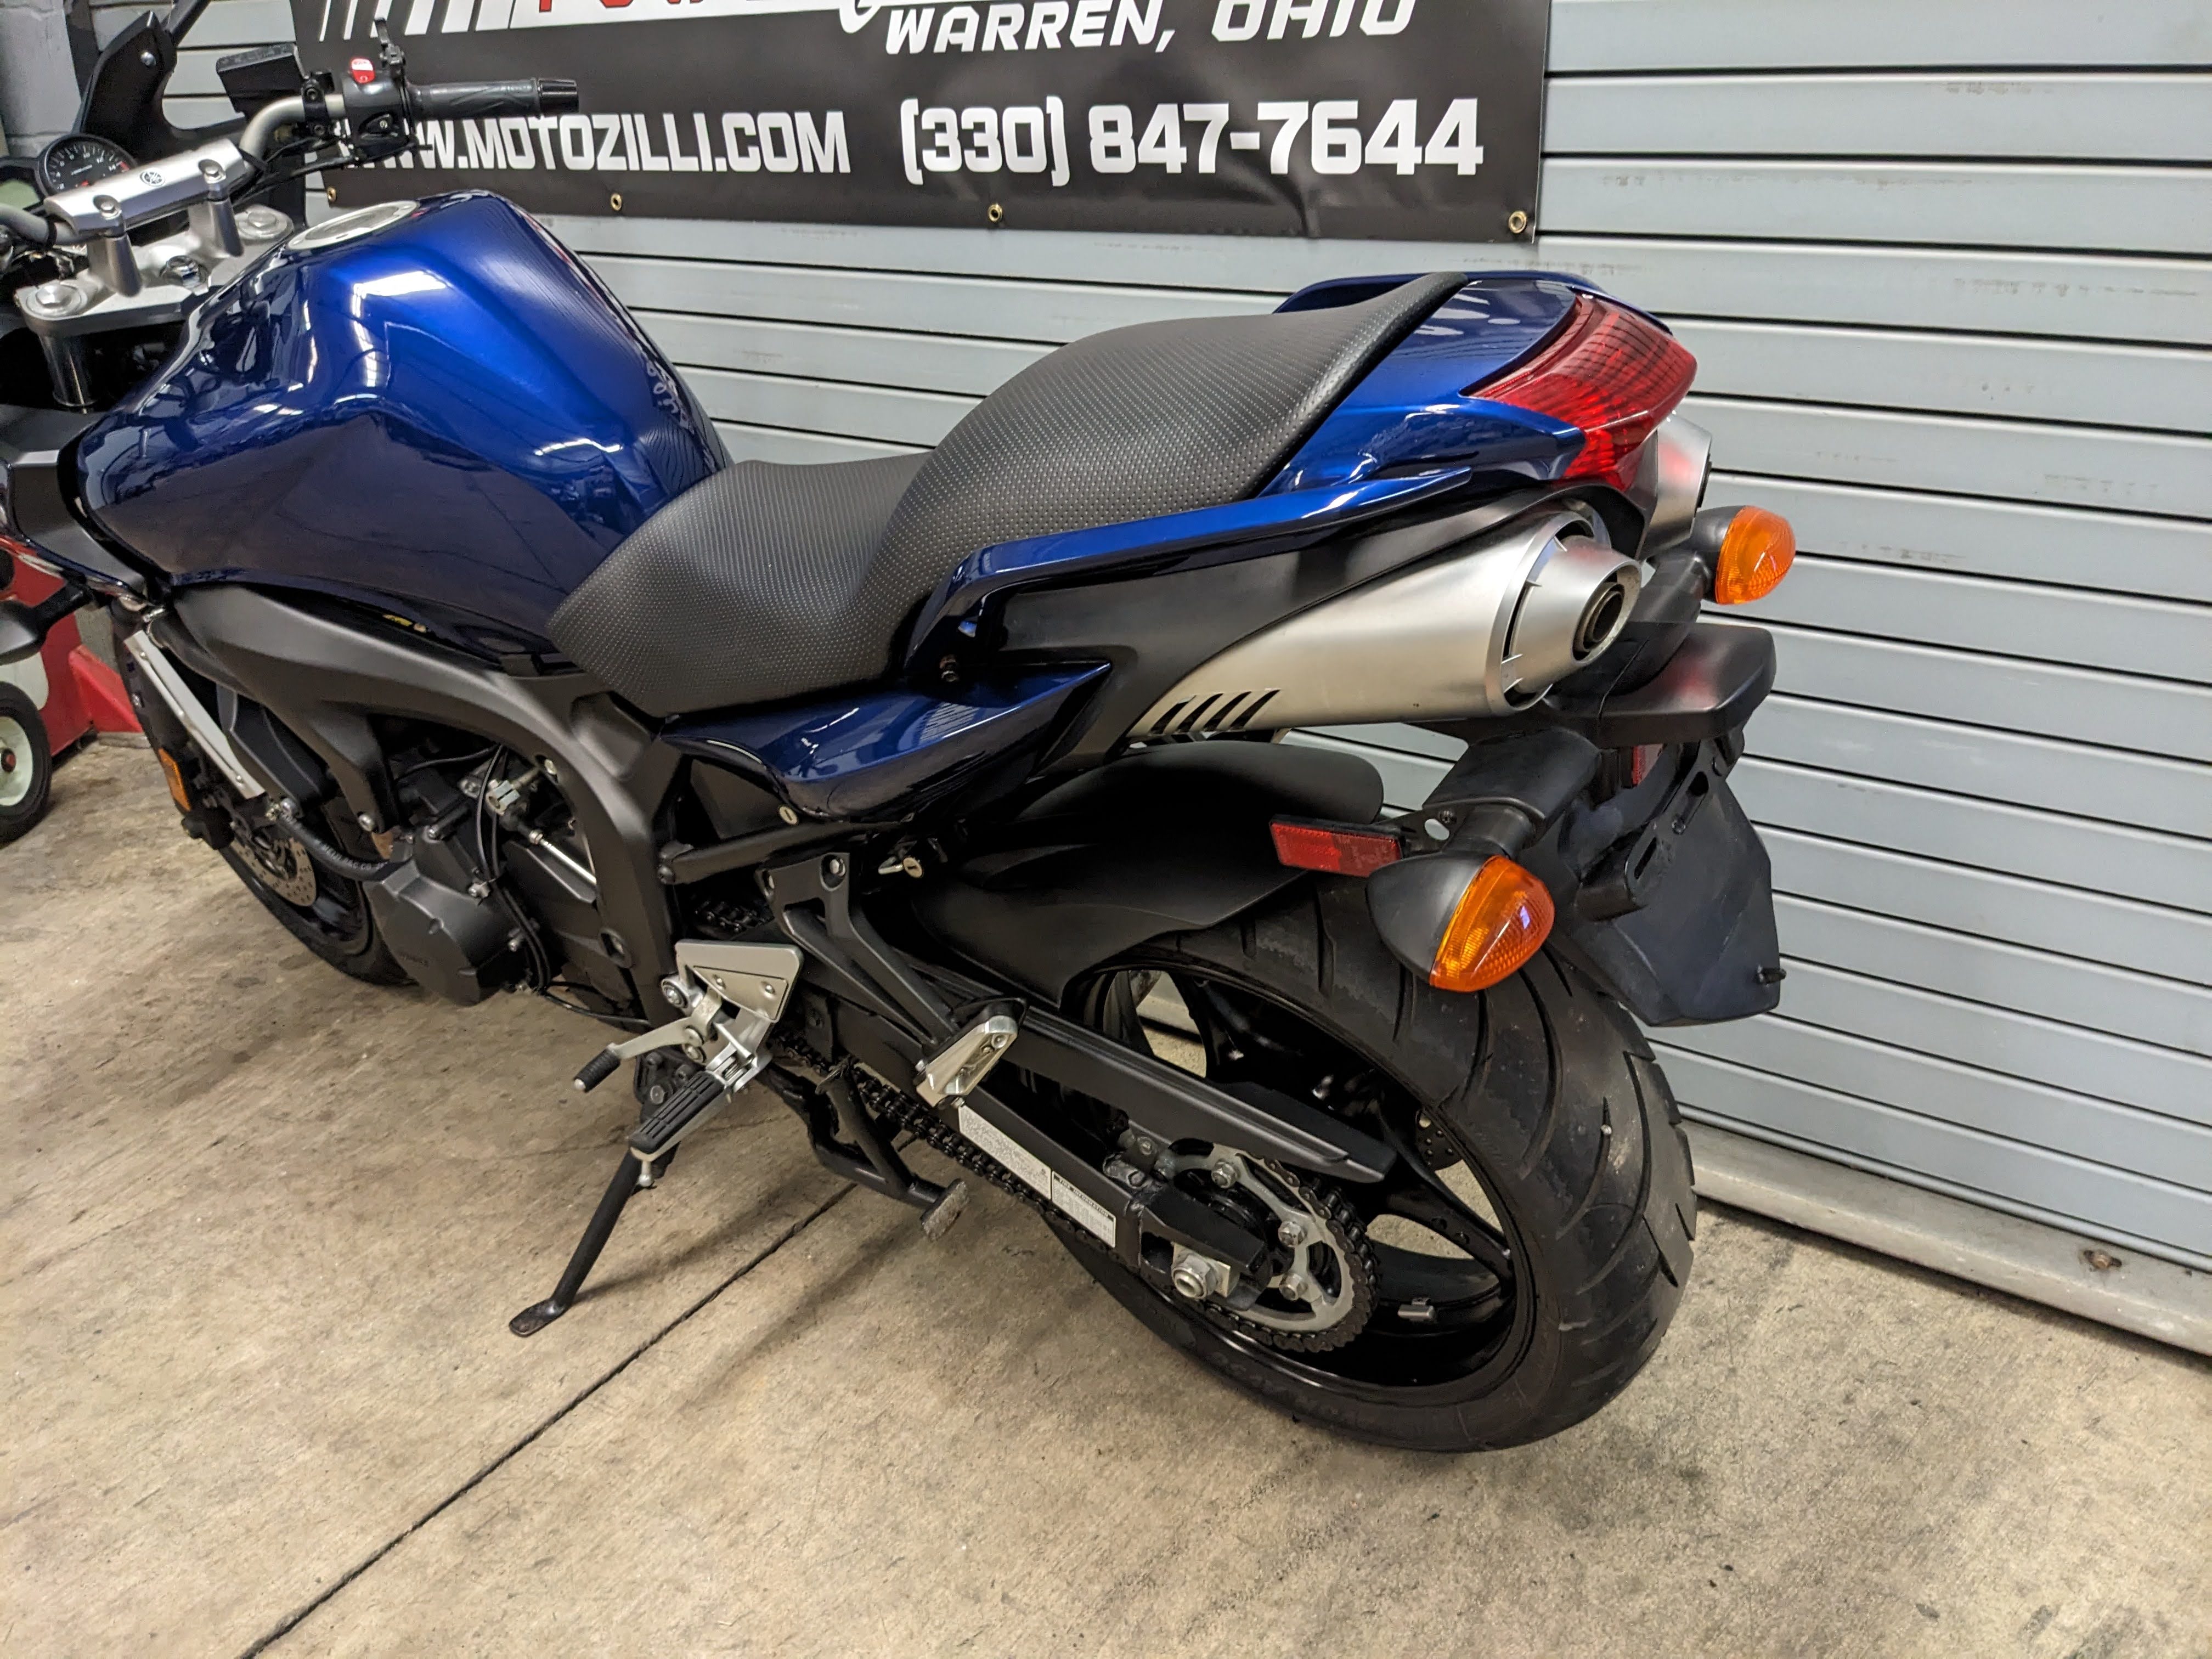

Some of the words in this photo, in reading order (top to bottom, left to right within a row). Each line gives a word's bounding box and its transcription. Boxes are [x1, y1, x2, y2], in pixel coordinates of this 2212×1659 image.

[886, 0, 1175, 54] WARREN,
[1211, 0, 1416, 42] OHIO
[900, 95, 1070, 187] (330)
[1089, 98, 1483, 176] 847-7644
